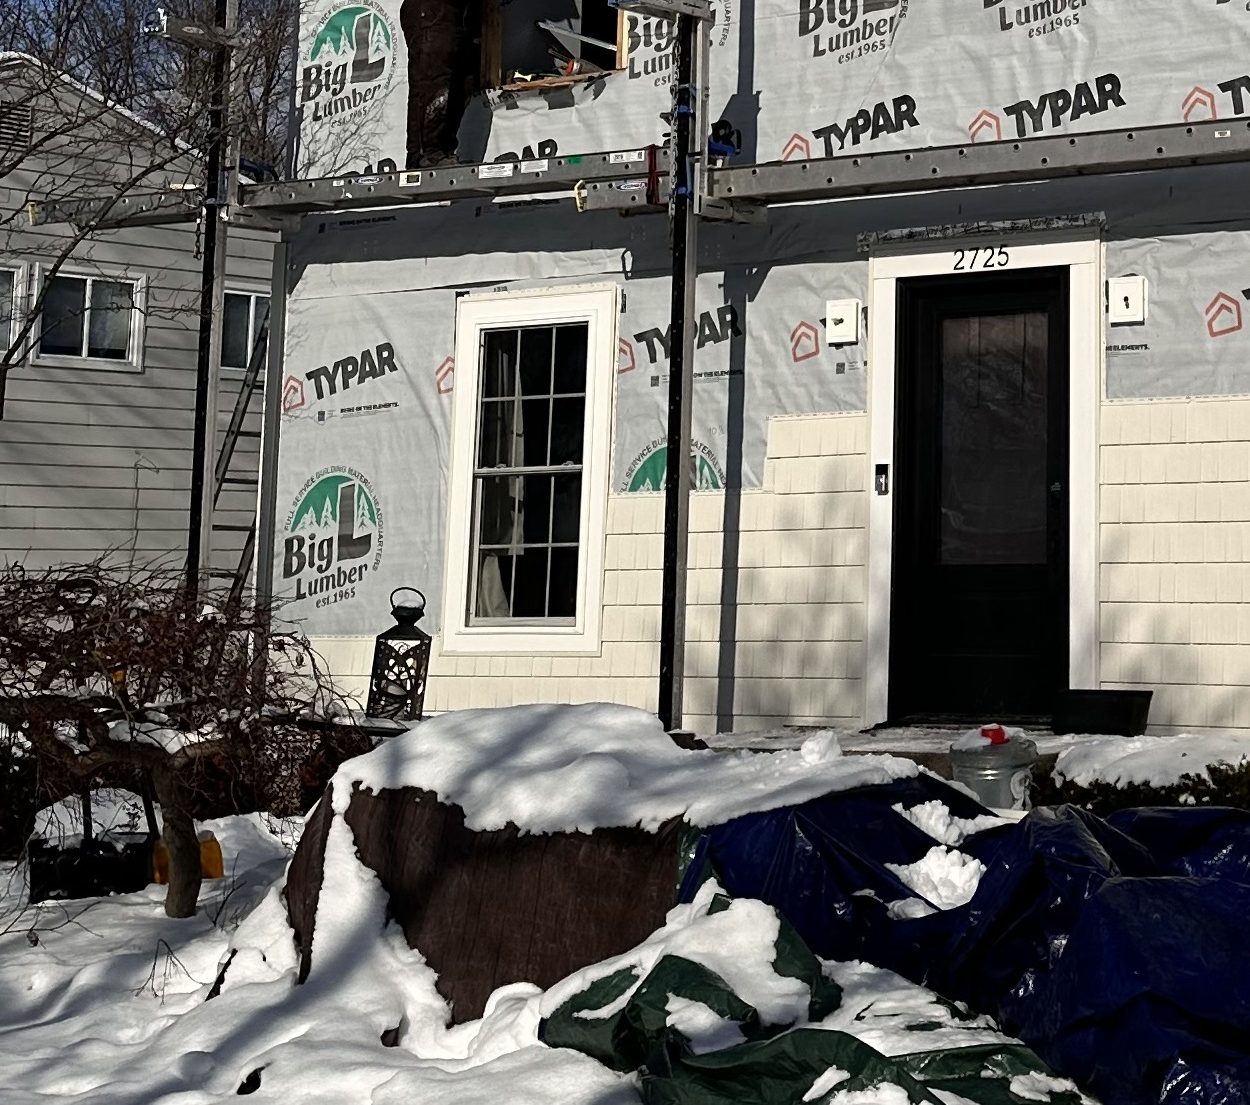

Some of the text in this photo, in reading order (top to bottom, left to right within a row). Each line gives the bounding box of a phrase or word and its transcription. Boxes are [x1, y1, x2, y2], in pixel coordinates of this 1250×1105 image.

[813, 14, 897, 57] Lumber
[301, 60, 348, 103] Big
[313, 84, 381, 121] Lumber
[812, 94, 920, 157] TYPAR
[1003, 73, 1126, 138] TYPAR
[953, 244, 1009, 270] 2725
[633, 304, 742, 363] TYAR
[305, 342, 398, 401] TYPAR
[283, 533, 334, 579] Big
[296, 563, 368, 600] Lumber
